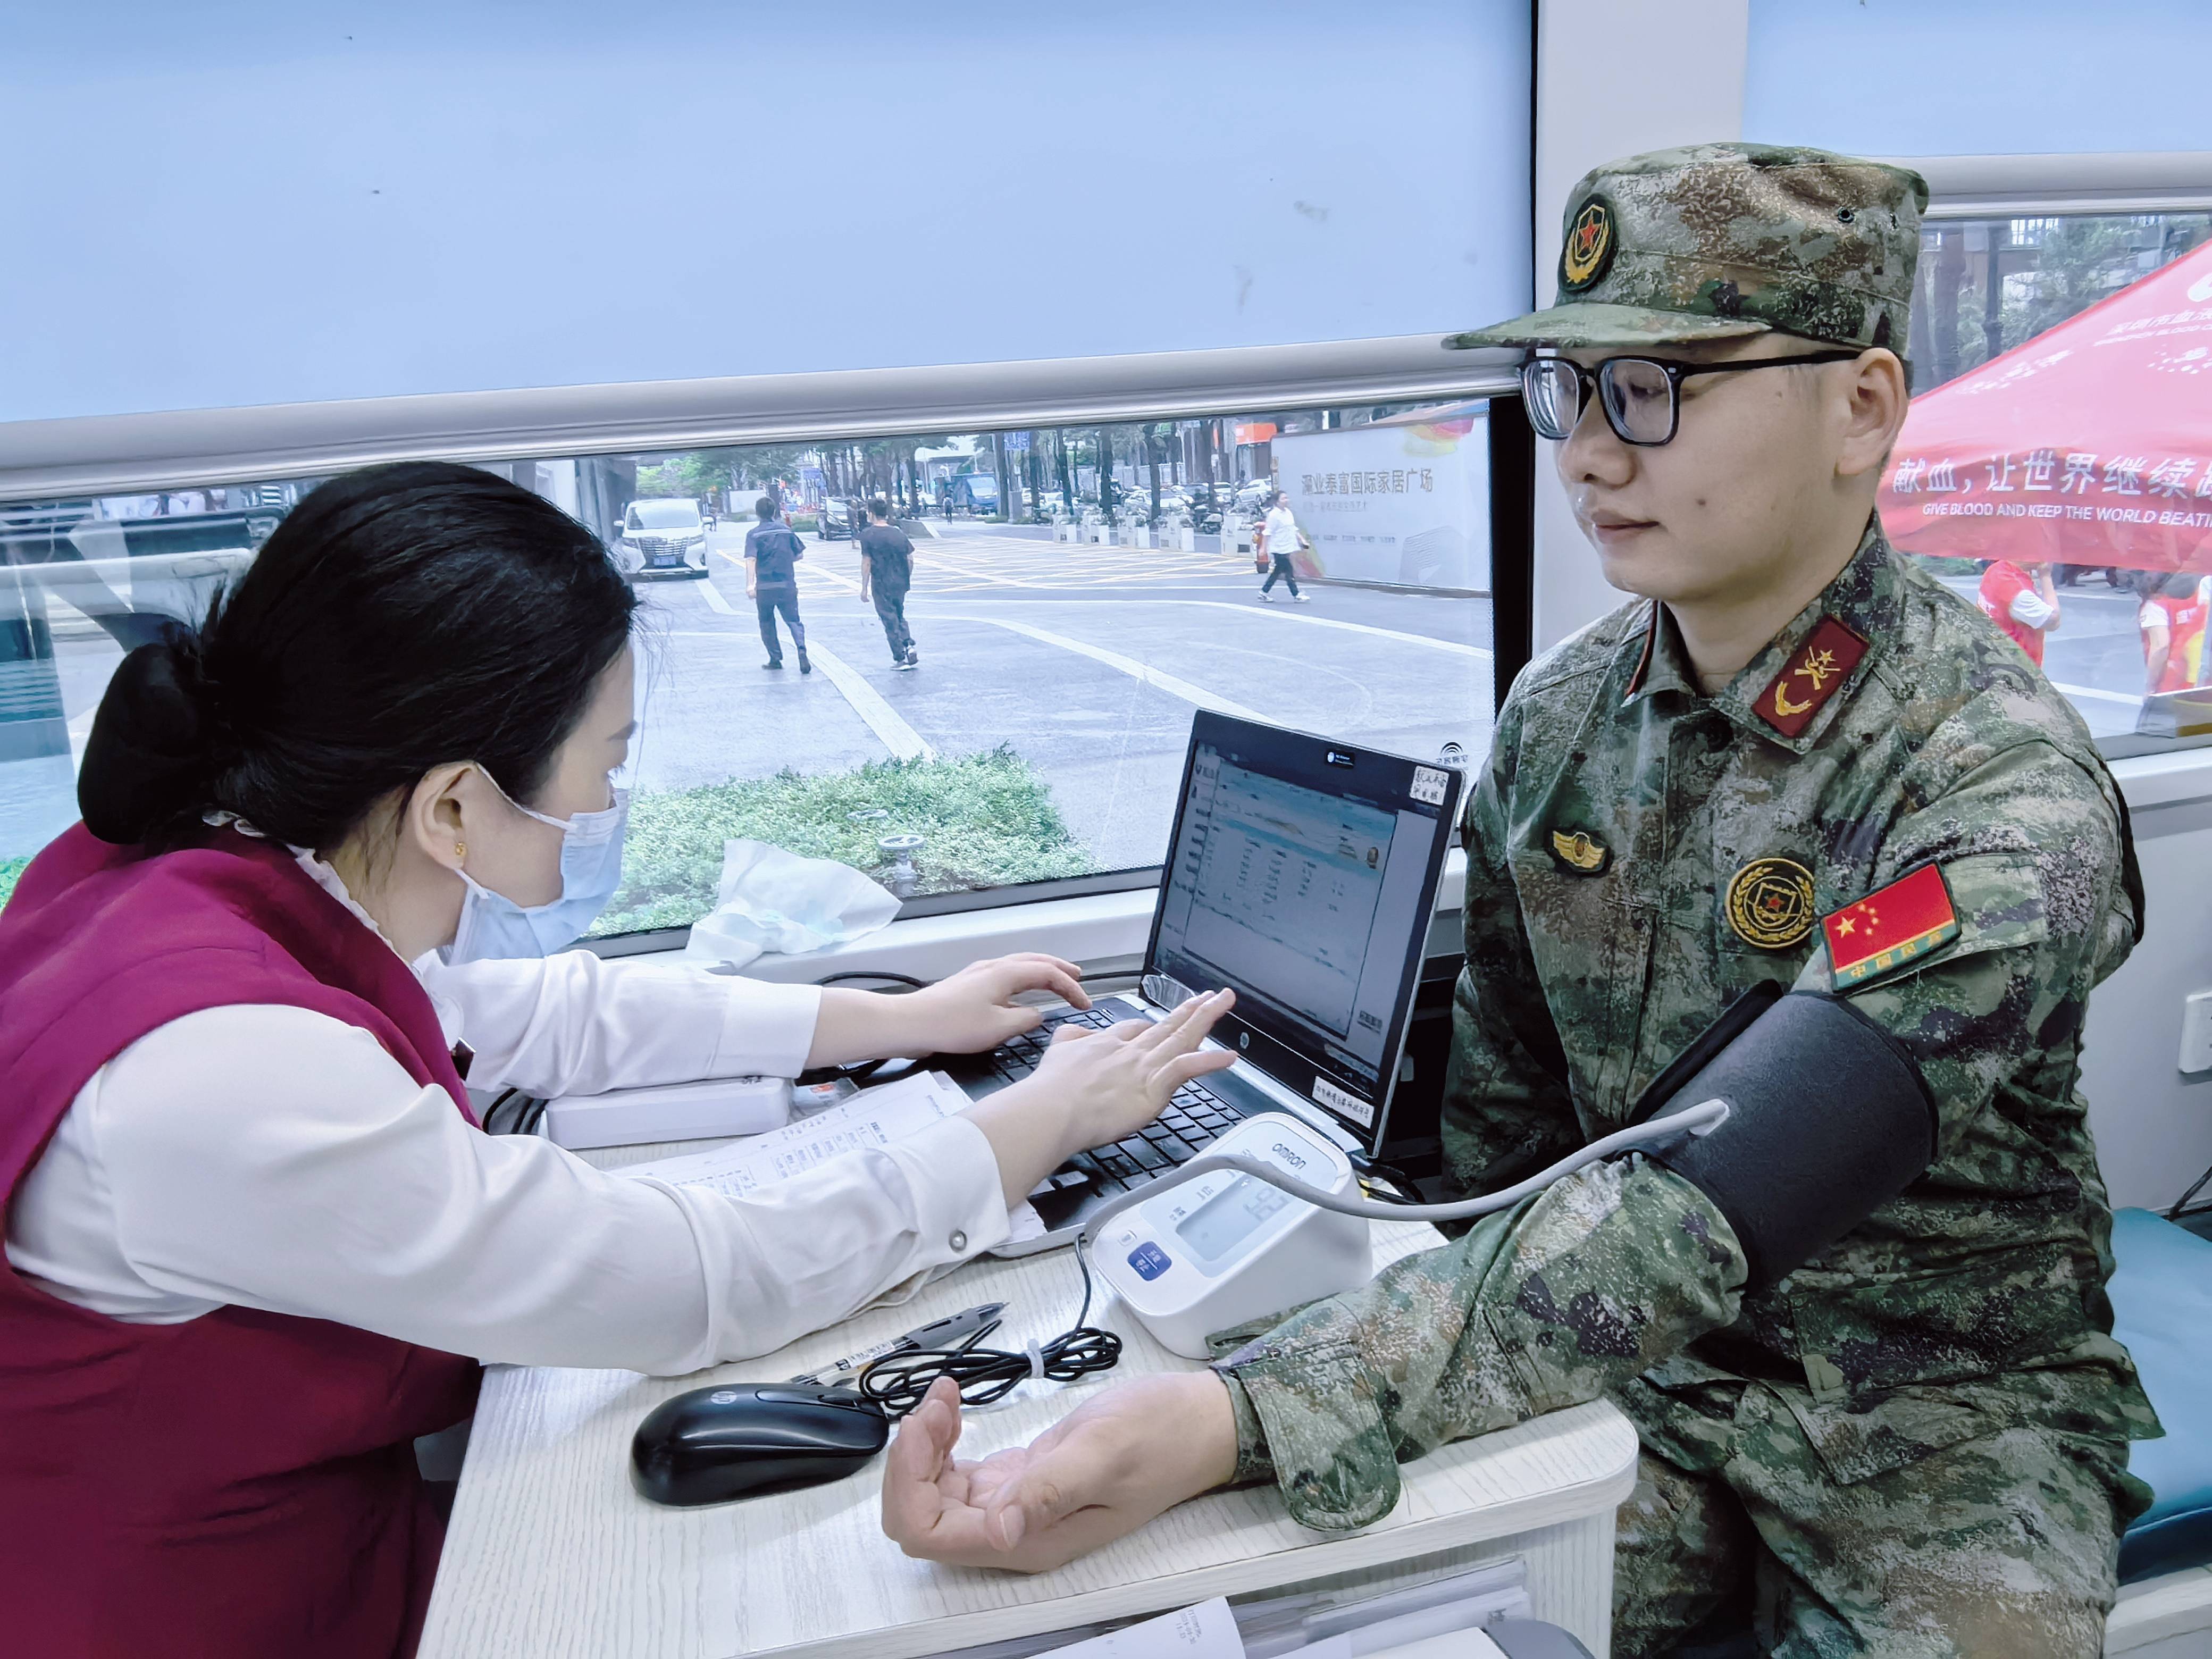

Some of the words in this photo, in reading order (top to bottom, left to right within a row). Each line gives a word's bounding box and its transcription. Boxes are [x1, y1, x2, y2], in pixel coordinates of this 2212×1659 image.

[1923, 503, 1949, 516] GIVE
[1950, 503, 1993, 516] BLOOD
[1997, 504, 2025, 517] AND
[2028, 505, 2062, 518] KEEP
[2066, 505, 2093, 520] THE
[2097, 507, 2157, 523] WORLD
